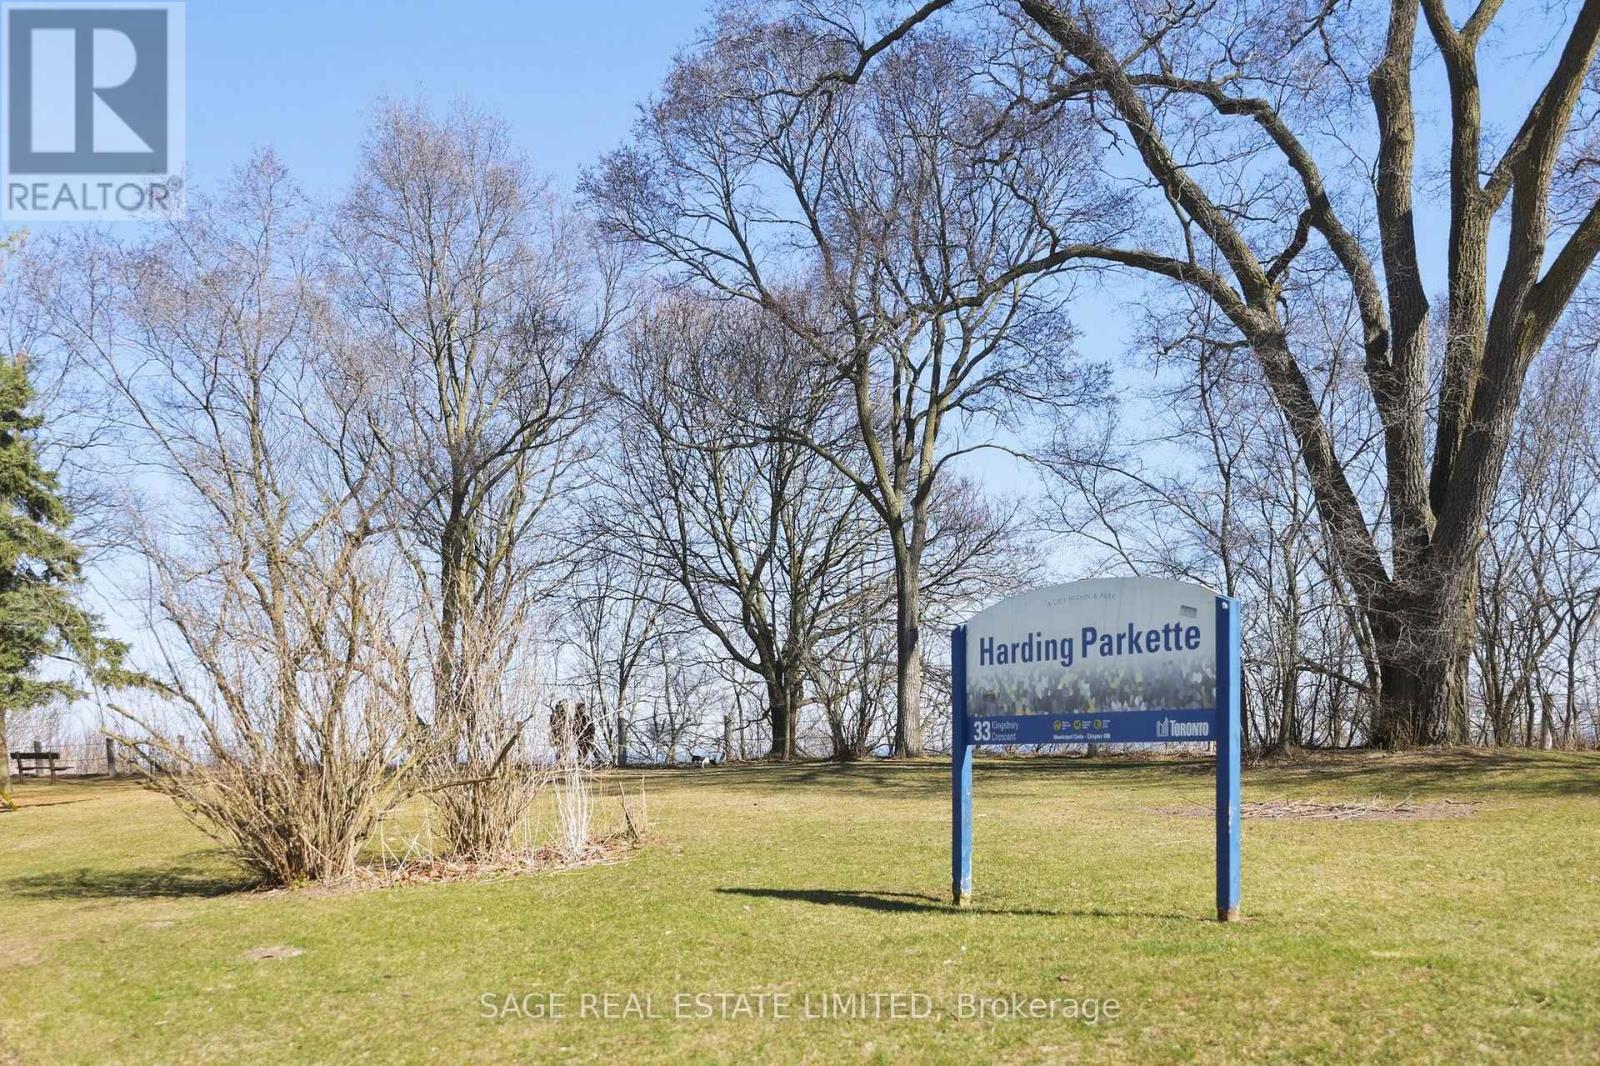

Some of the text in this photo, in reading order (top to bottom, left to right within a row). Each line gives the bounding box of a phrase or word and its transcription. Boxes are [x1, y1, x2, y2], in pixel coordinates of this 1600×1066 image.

[979, 622, 1201, 667] Harding Parkette
[973, 720, 991, 741] 33
[991, 720, 1019, 731] Kingsbury
[1169, 720, 1209, 737] TORONTO
[991, 733, 1016, 741] Crescent
